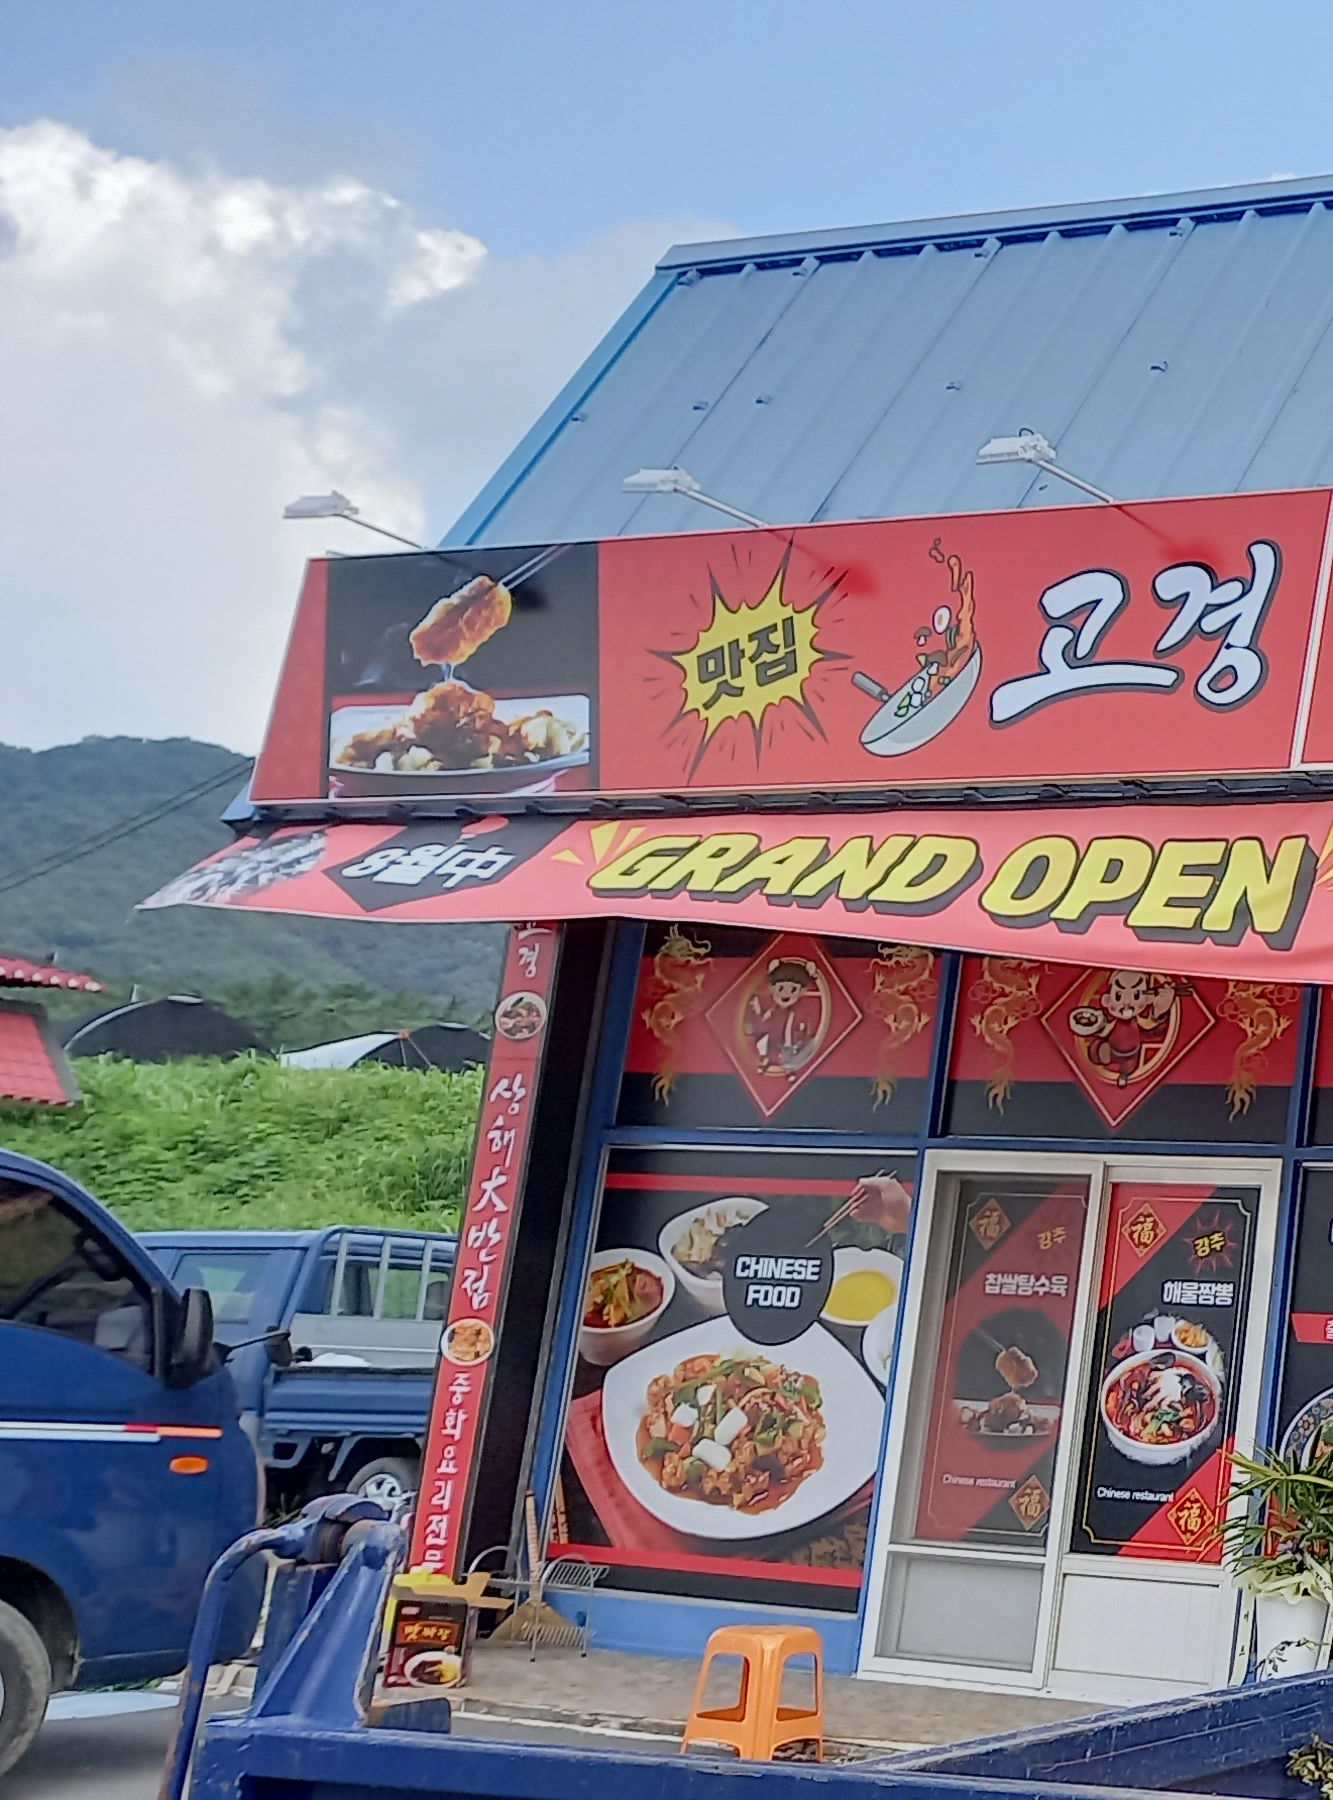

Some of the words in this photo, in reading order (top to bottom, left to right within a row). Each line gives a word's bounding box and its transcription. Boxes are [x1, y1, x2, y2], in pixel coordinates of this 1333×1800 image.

[989, 541, 1281, 725] 고경
[695, 614, 798, 710] 맛집
[587, 833, 982, 904] GRAND
[980, 836, 1311, 935] OPEN
[1037, 1226, 1067, 1250] 강추
[1193, 1231, 1226, 1257] 강추
[735, 1256, 820, 1282] CHINESE
[984, 1272, 1069, 1297] 찹쌀탕수육
[1163, 1281, 1235, 1306] 해물짬뽕
[747, 1285, 800, 1310] FOOD
[942, 1473, 975, 1488] Chinese
[1096, 1486, 1131, 1500] Chinese
[1131, 1489, 1175, 1503] restaurant
